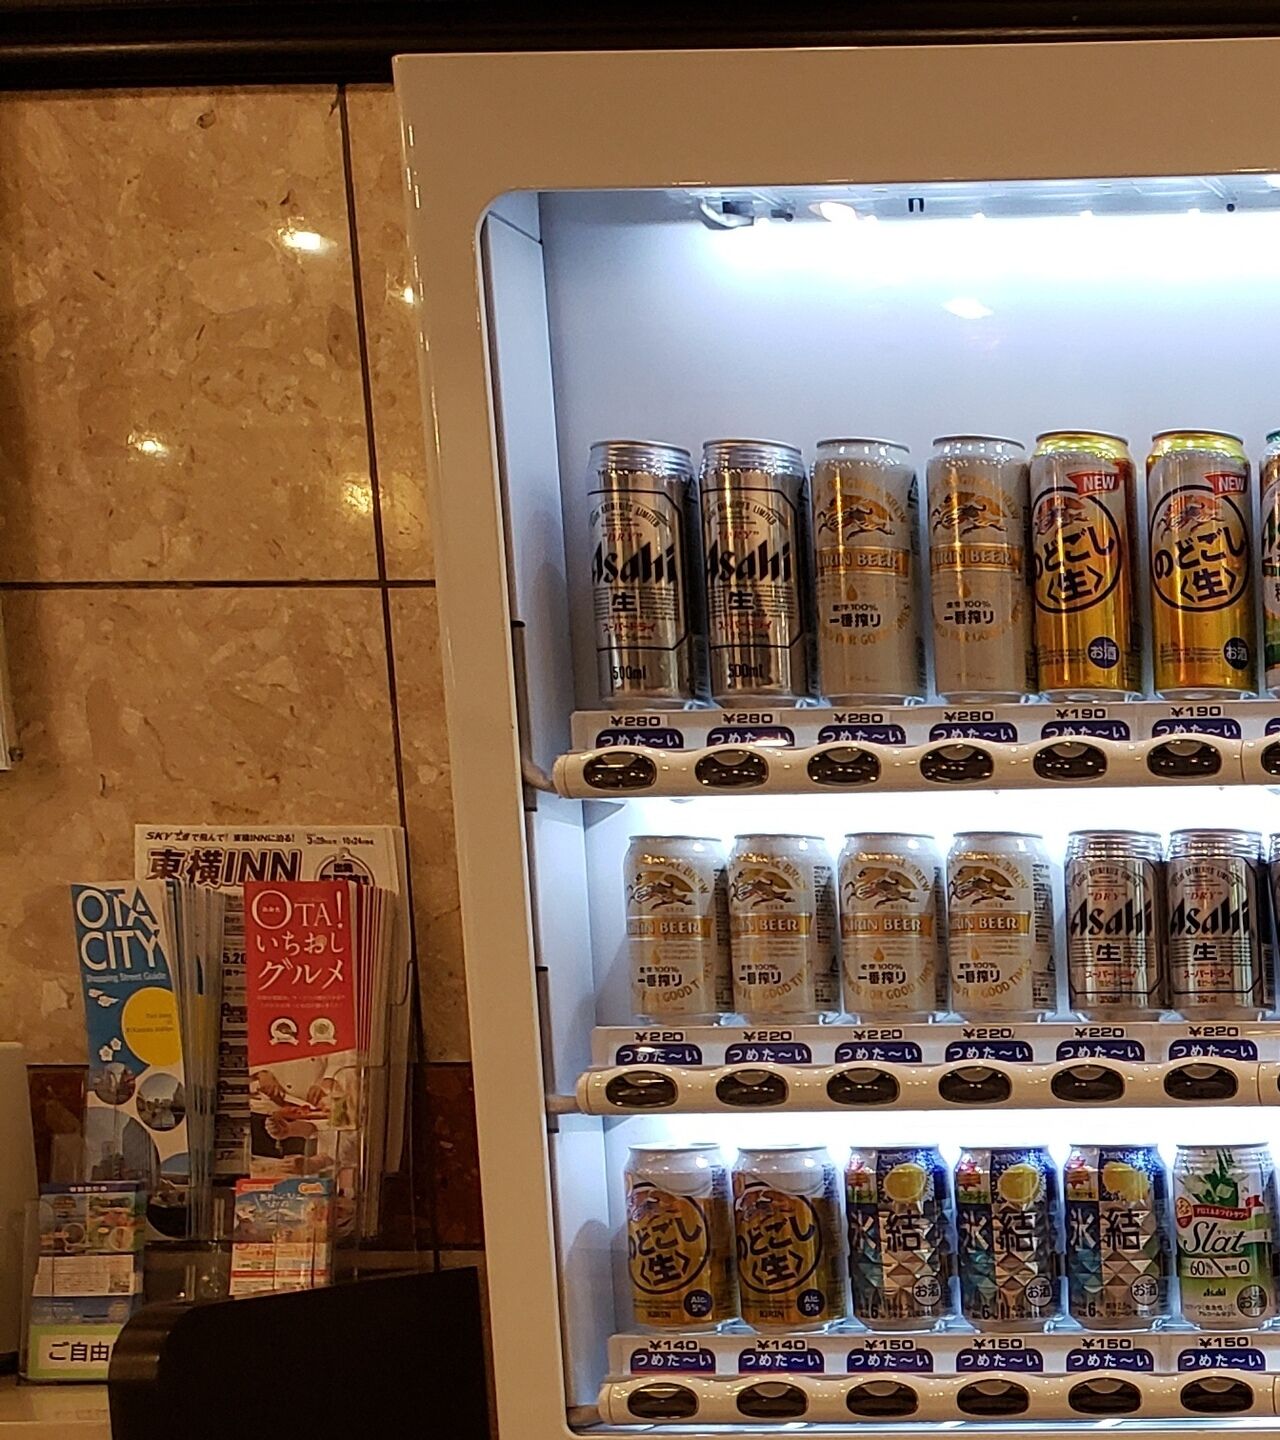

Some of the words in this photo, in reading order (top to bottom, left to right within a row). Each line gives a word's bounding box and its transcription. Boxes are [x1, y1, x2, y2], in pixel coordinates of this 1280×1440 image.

[1081, 474, 1115, 492] NEW
[1218, 477, 1246, 492] NEW
[969, 549, 1012, 569] BEER
[1156, 526, 1248, 579] のどごし
[612, 592, 637, 612] 生
[830, 613, 880, 628] 一番搾り
[944, 610, 994, 625] 一番搾り
[1226, 642, 1248, 662] お酒
[612, 665, 646, 680] 500ml
[723, 713, 773, 724] ¥280
[834, 712, 884, 723] ¥280
[945, 710, 994, 722] ¥280
[1056, 709, 1106, 720] ¥190
[1171, 706, 1221, 717] ¥190
[611, 715, 660, 727] ¥280
[147, 849, 301, 886] 東横INN
[77, 887, 158, 929] OTA
[660, 915, 700, 934] BEER
[979, 916, 1018, 931] BEER
[1171, 898, 1250, 936] Asahi
[257, 931, 343, 953] いちおし
[81, 931, 160, 971] CITY
[1193, 943, 1218, 963] 生
[258, 958, 343, 990] グルメ
[637, 971, 683, 987] 一番搾り
[857, 969, 907, 986] 一番搾り
[635, 1031, 683, 1042] ¥220
[853, 1029, 902, 1040] ¥220
[1074, 1027, 1124, 1039] ¥220
[850, 1210, 928, 1252] 氷結
[1070, 1210, 1144, 1252] 氷結
[1184, 1221, 1247, 1254] Slat
[915, 1283, 942, 1298] お酒
[757, 1340, 806, 1351] ¥140
[865, 1340, 914, 1351] ¥150
[1082, 1338, 1132, 1349] ¥150
[1199, 1336, 1249, 1347] ¥150
[49, 1341, 110, 1362] ご自由
